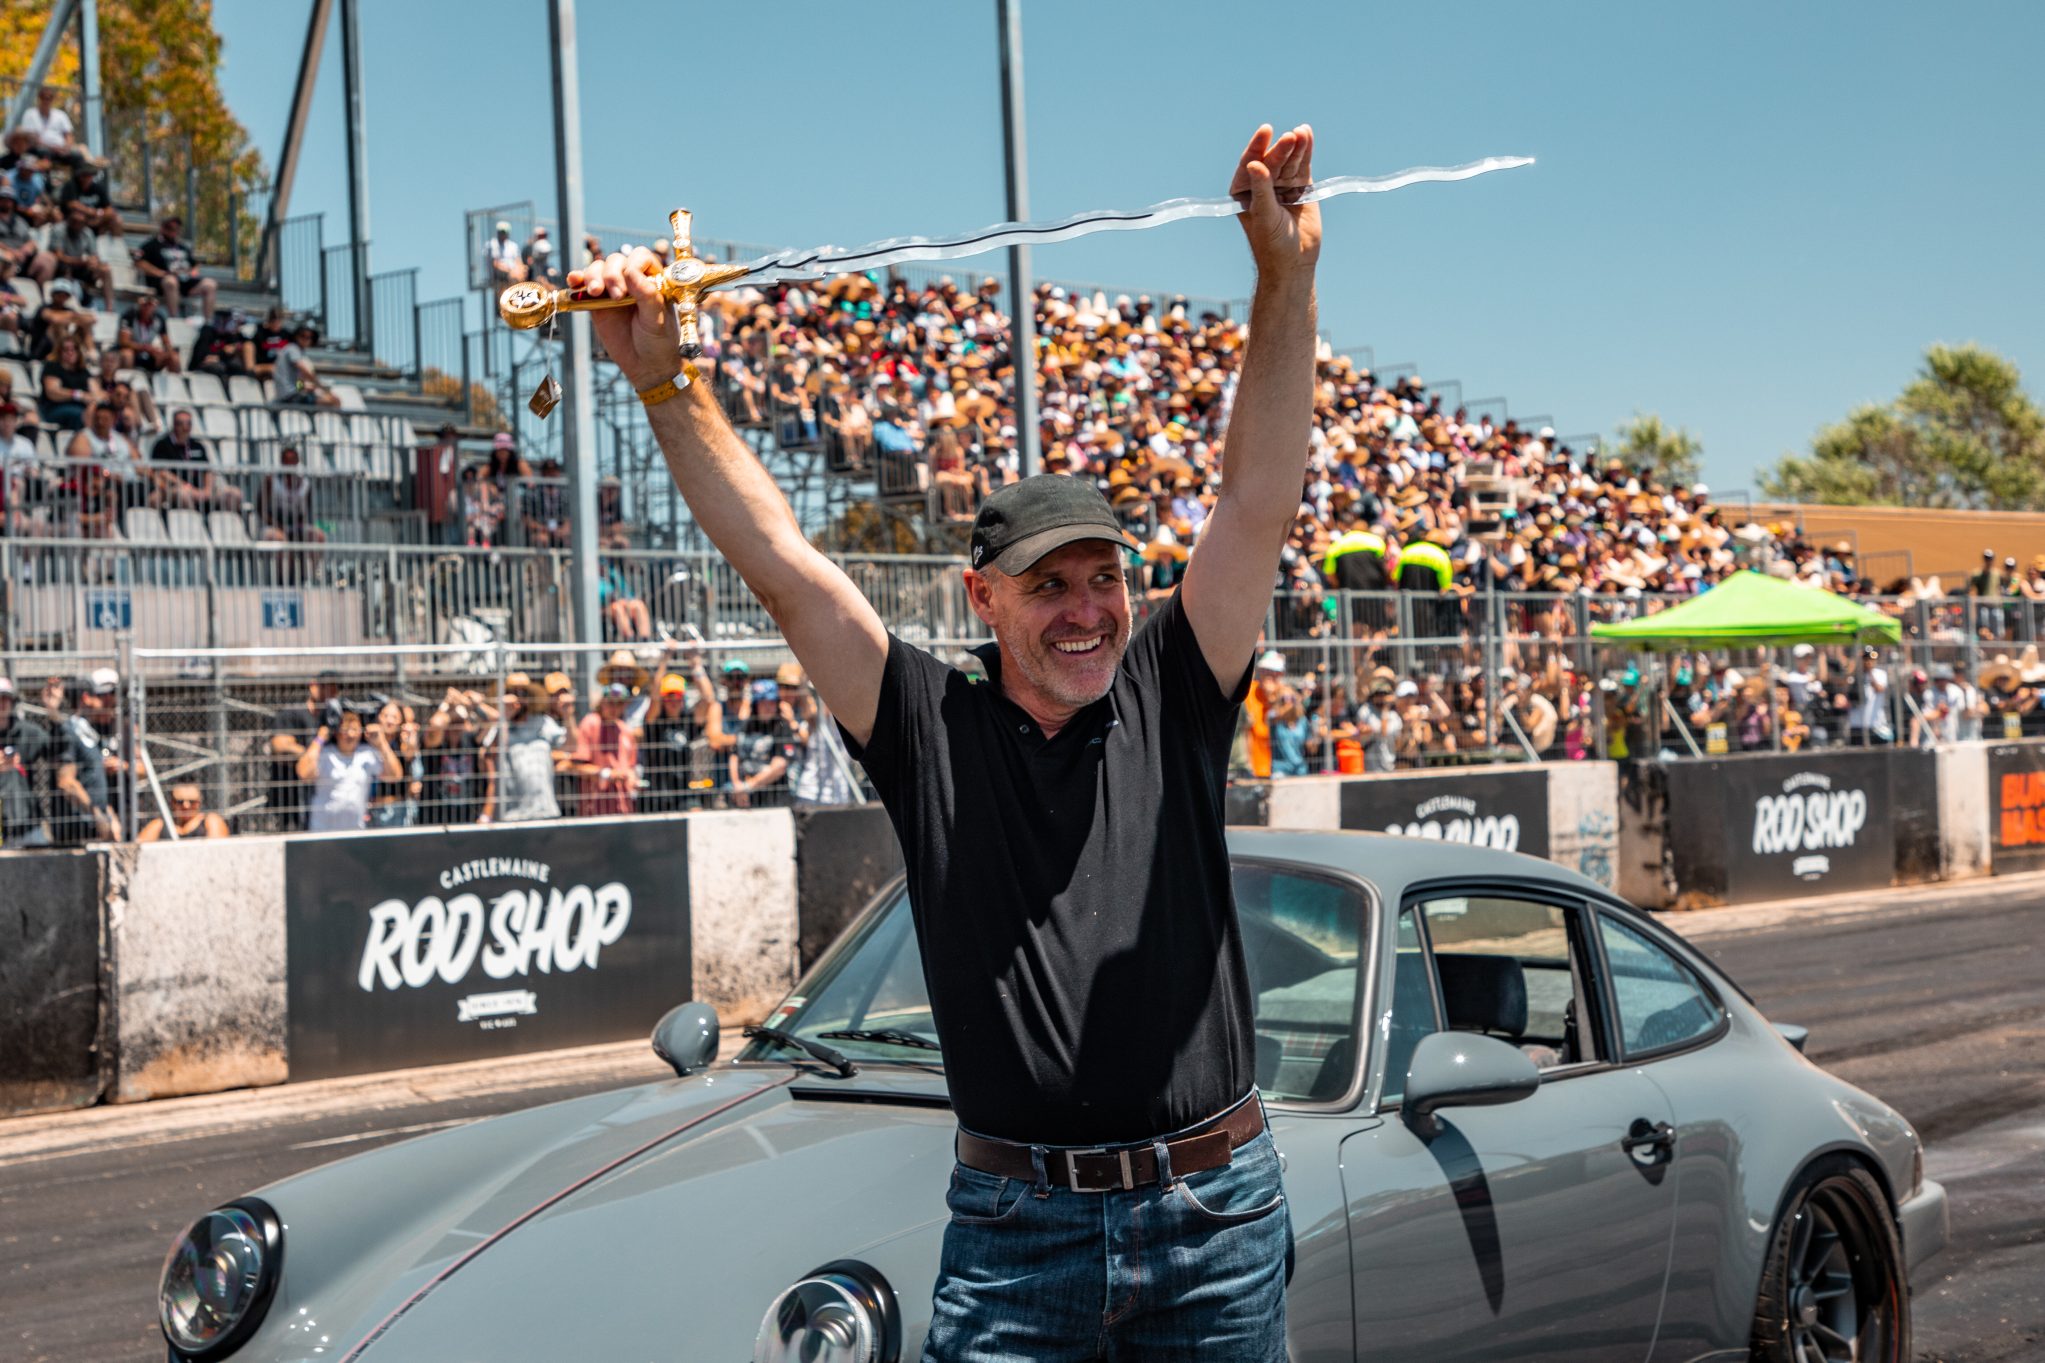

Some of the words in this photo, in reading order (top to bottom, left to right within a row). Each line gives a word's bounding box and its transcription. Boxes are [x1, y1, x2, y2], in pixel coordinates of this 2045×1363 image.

[1753, 794, 1805, 854] ROD
[1803, 789, 1866, 850] SHOP
[440, 857, 550, 889] CASTLEMAINE
[358, 893, 485, 992] ROD
[482, 882, 632, 979] SHOP
